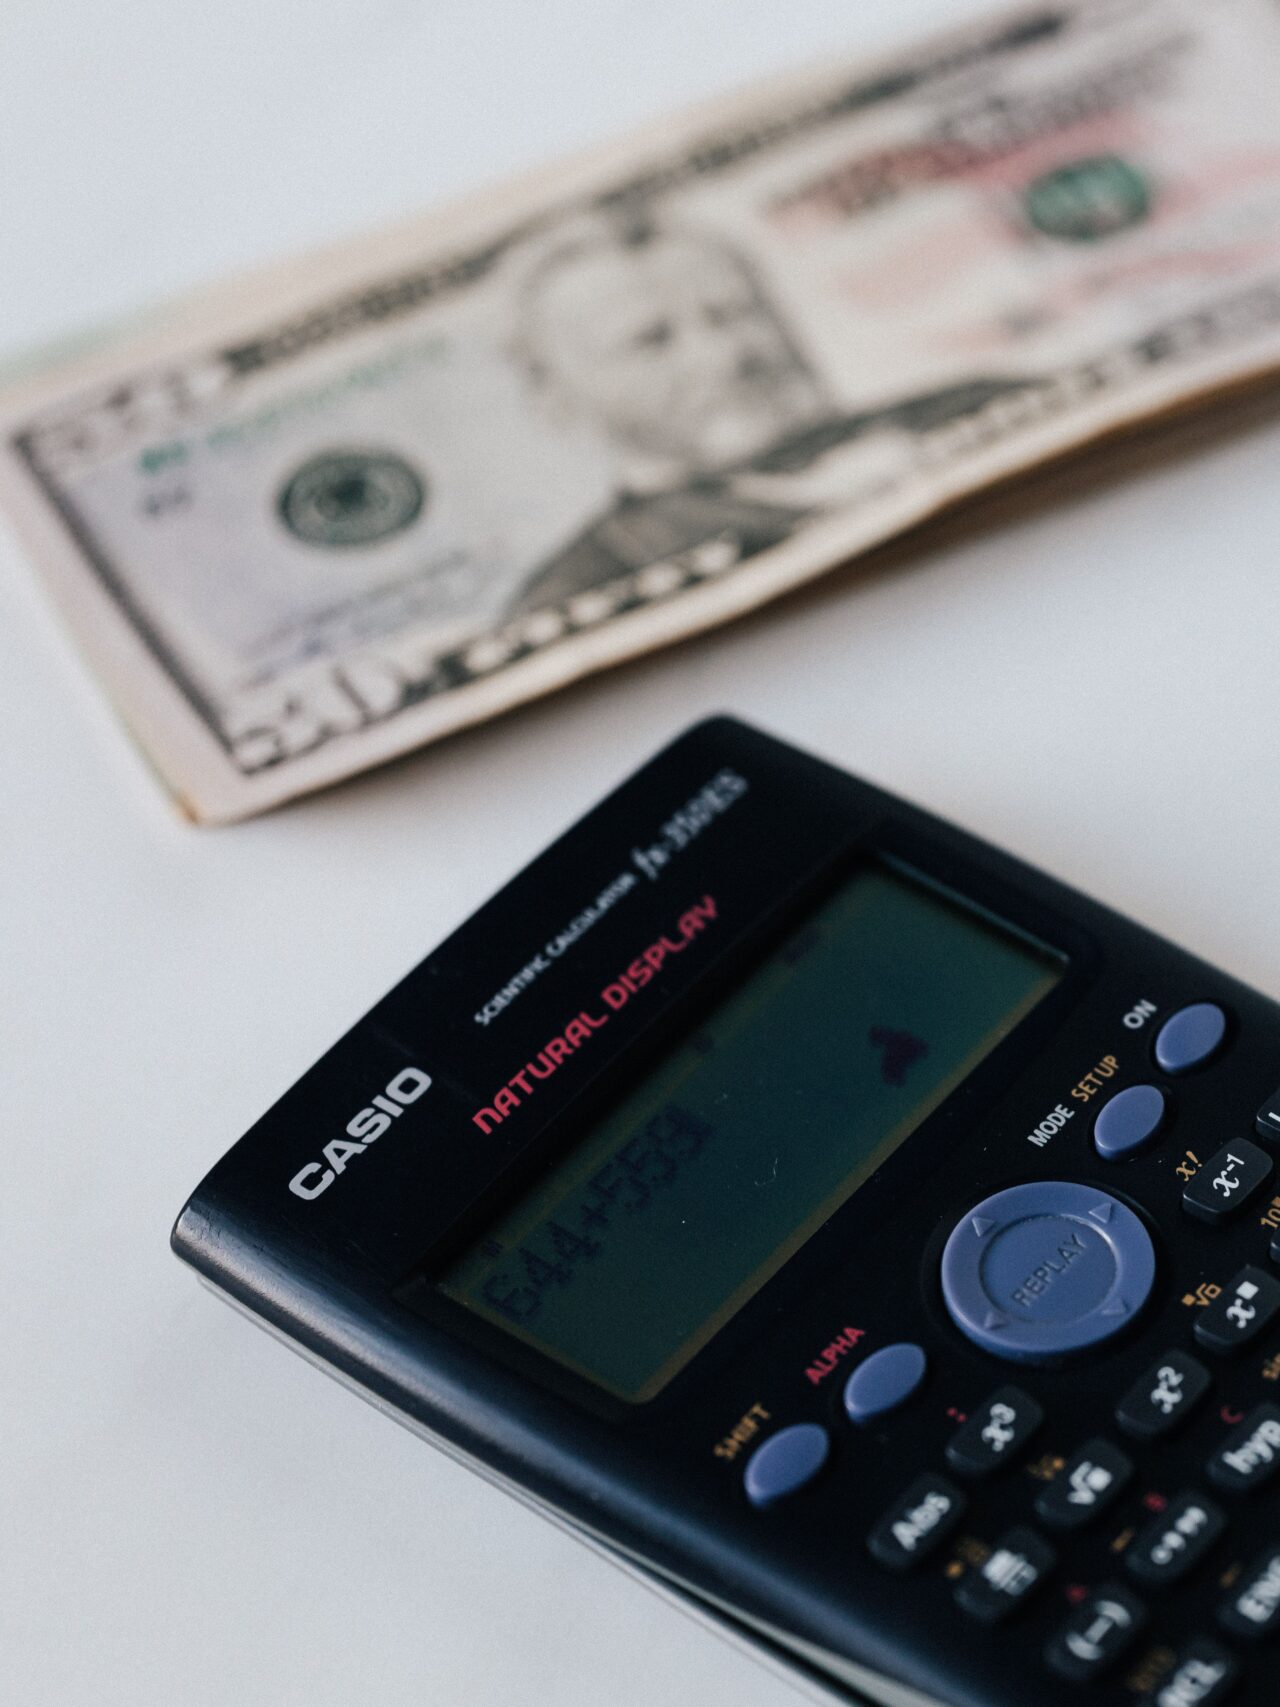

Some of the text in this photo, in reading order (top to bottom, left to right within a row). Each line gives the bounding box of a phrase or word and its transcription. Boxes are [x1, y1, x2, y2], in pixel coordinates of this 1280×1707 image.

[471, 895, 720, 1135] NATURAL DISPLAY
[1123, 999, 1157, 1029] ON
[288, 1067, 432, 1200] CASIO
[1027, 1055, 1120, 1147] MODE SETUP
[1010, 1232, 1088, 1308] REPLAY
[804, 1326, 865, 1385] ALPHA
